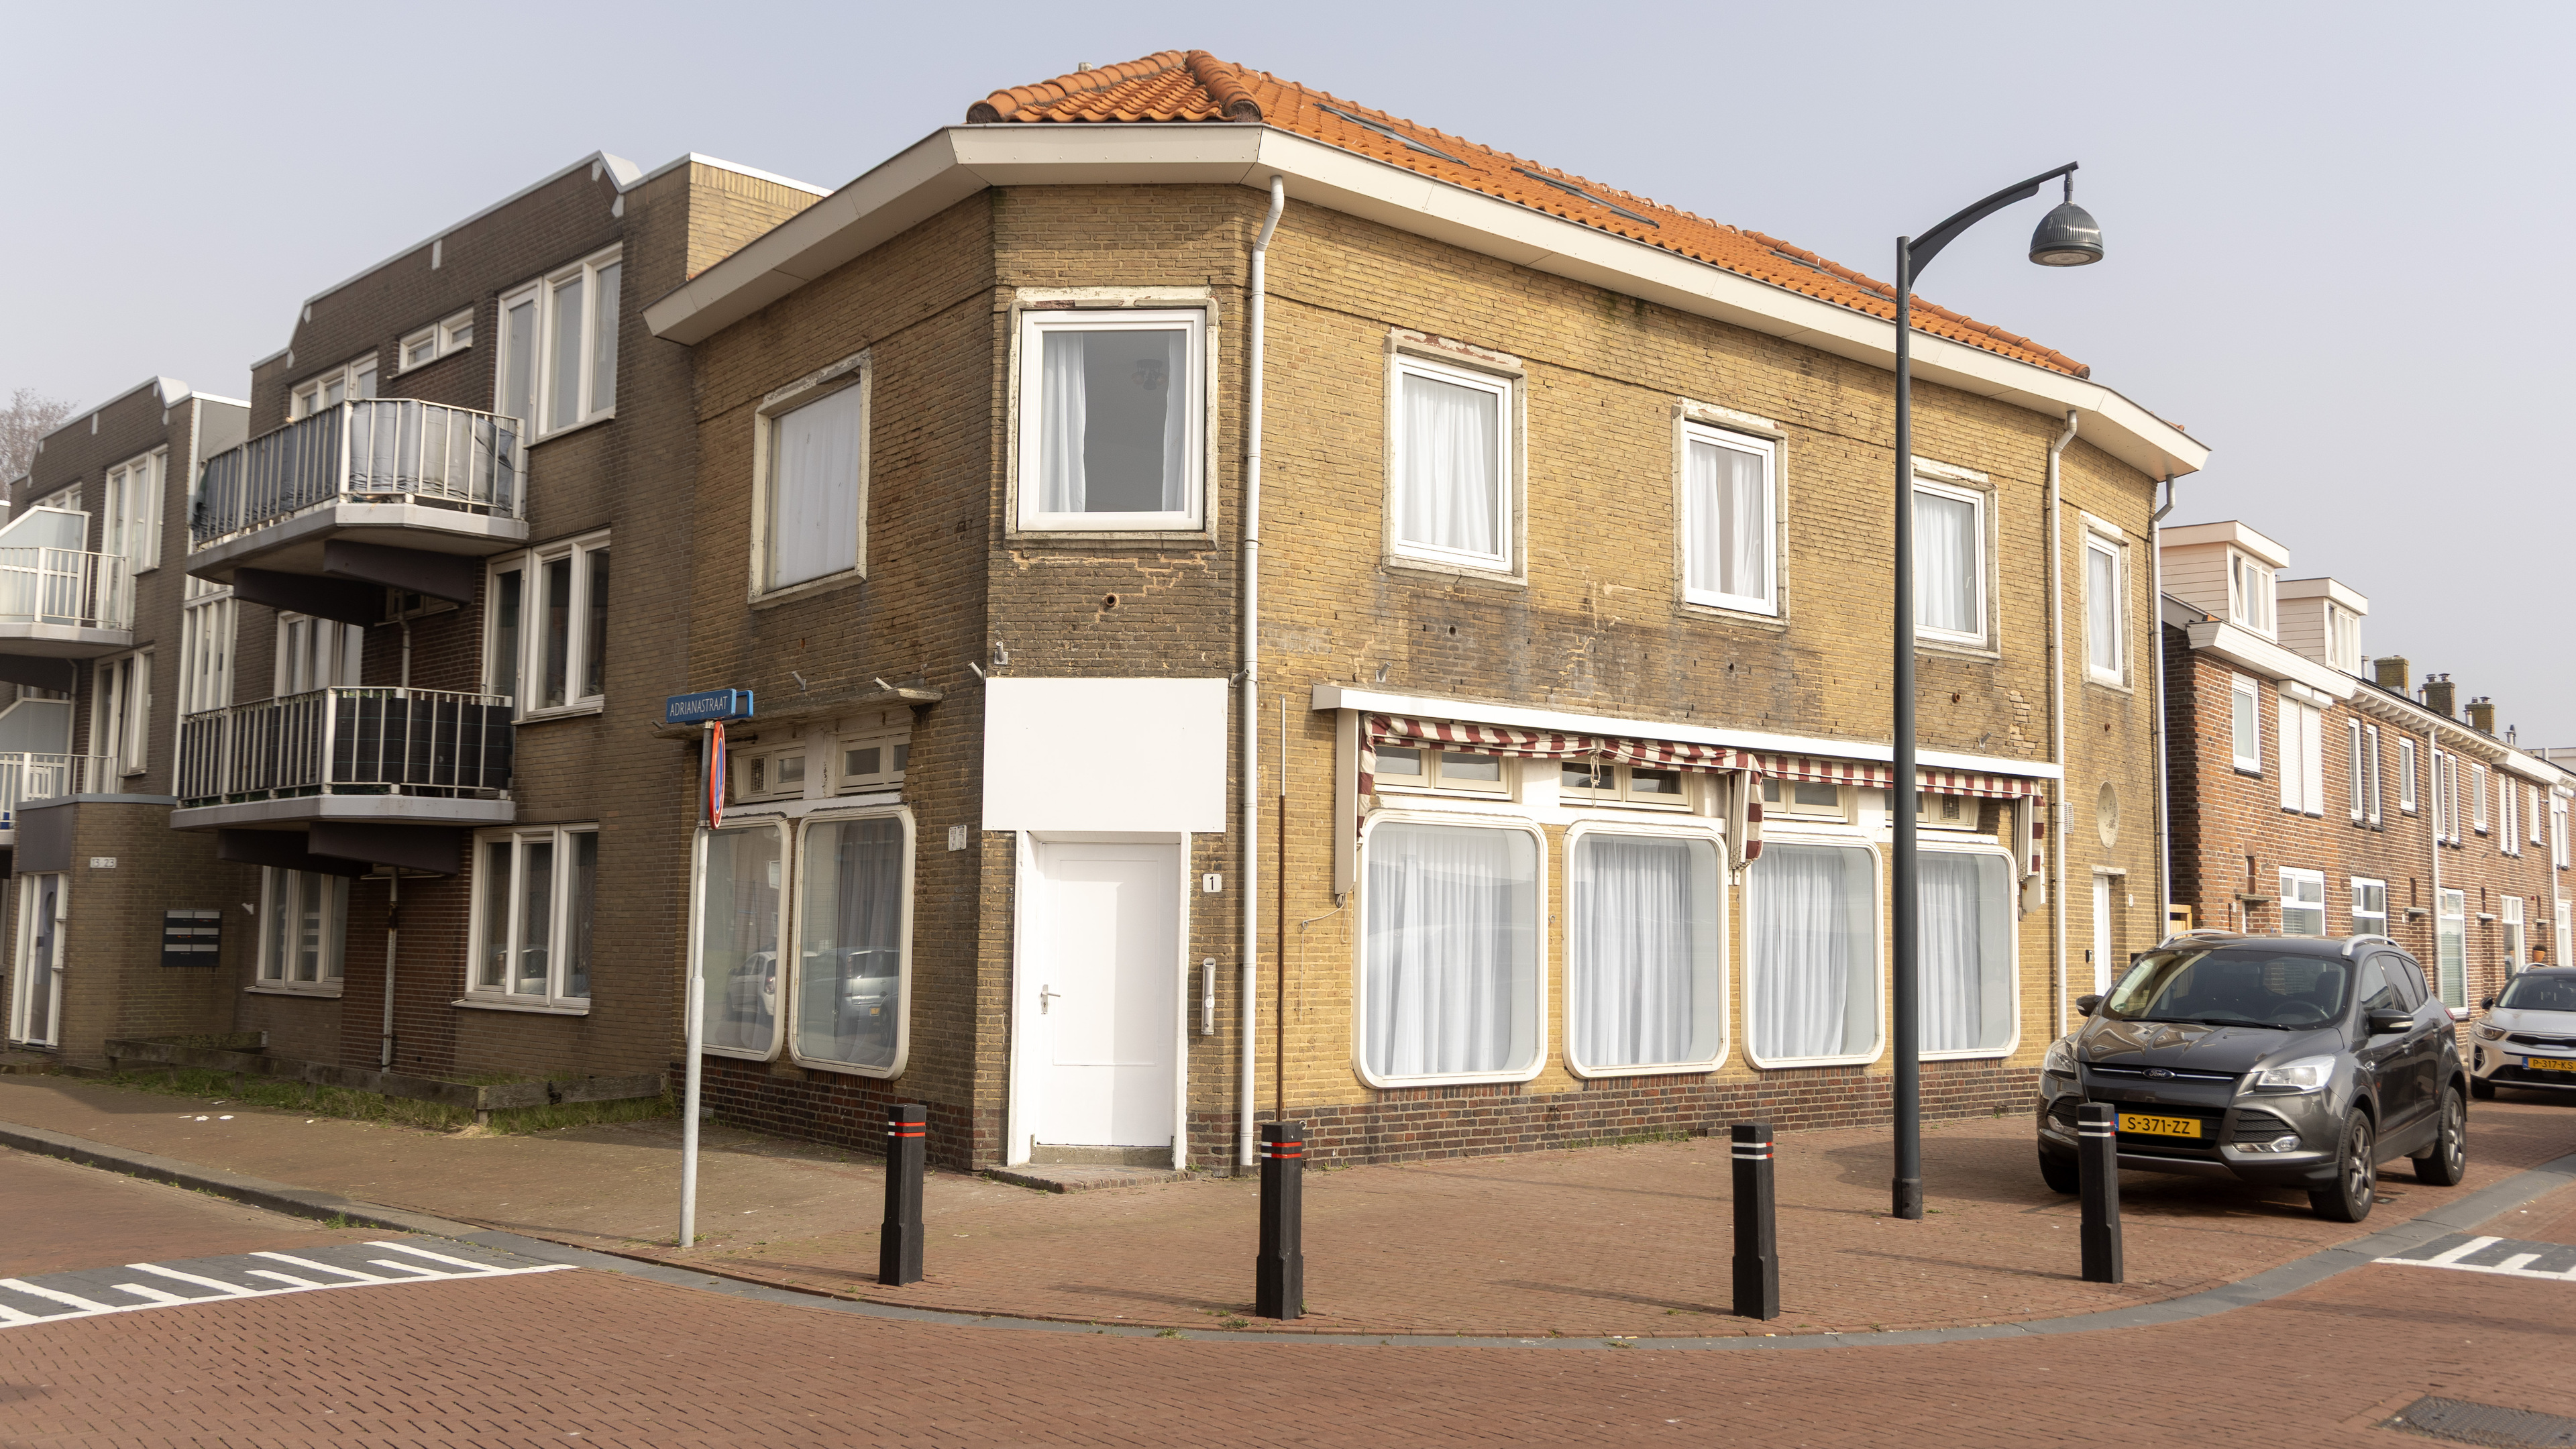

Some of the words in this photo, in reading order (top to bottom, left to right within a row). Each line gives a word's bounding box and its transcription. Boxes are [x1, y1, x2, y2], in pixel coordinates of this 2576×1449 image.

[669, 696, 728, 716] ADRIANASTRAAT
[1210, 875, 1214, 891] 1
[2532, 1059, 2574, 1070] P-317-KS
[2149, 1069, 2166, 1077] Ford
[2127, 1116, 2190, 1135] S-371-ZZ
